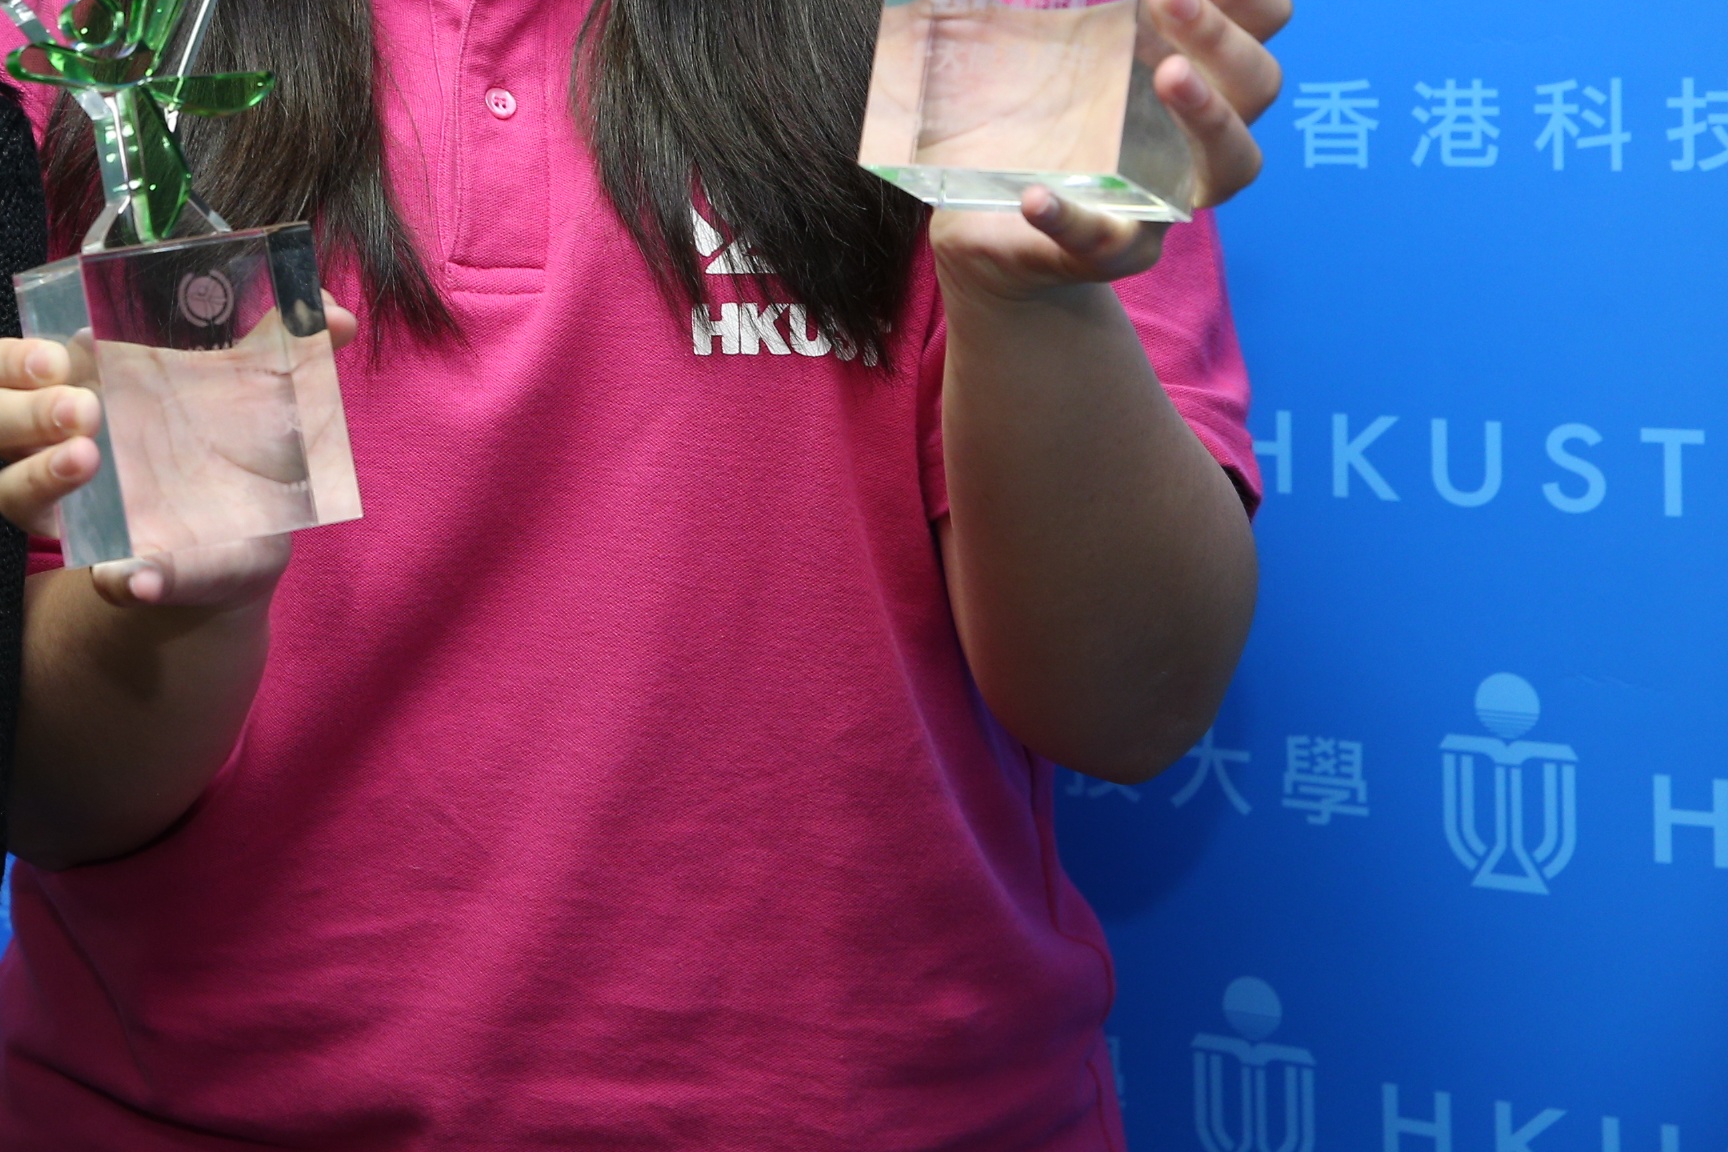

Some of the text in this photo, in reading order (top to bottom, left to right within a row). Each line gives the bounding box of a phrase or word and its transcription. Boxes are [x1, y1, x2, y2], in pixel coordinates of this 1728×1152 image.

[1292, 77, 1728, 172] 香港科技
[691, 302, 892, 367] HKU
[1255, 410, 1705, 517] HKUST
[1064, 725, 1370, 826] 大學
